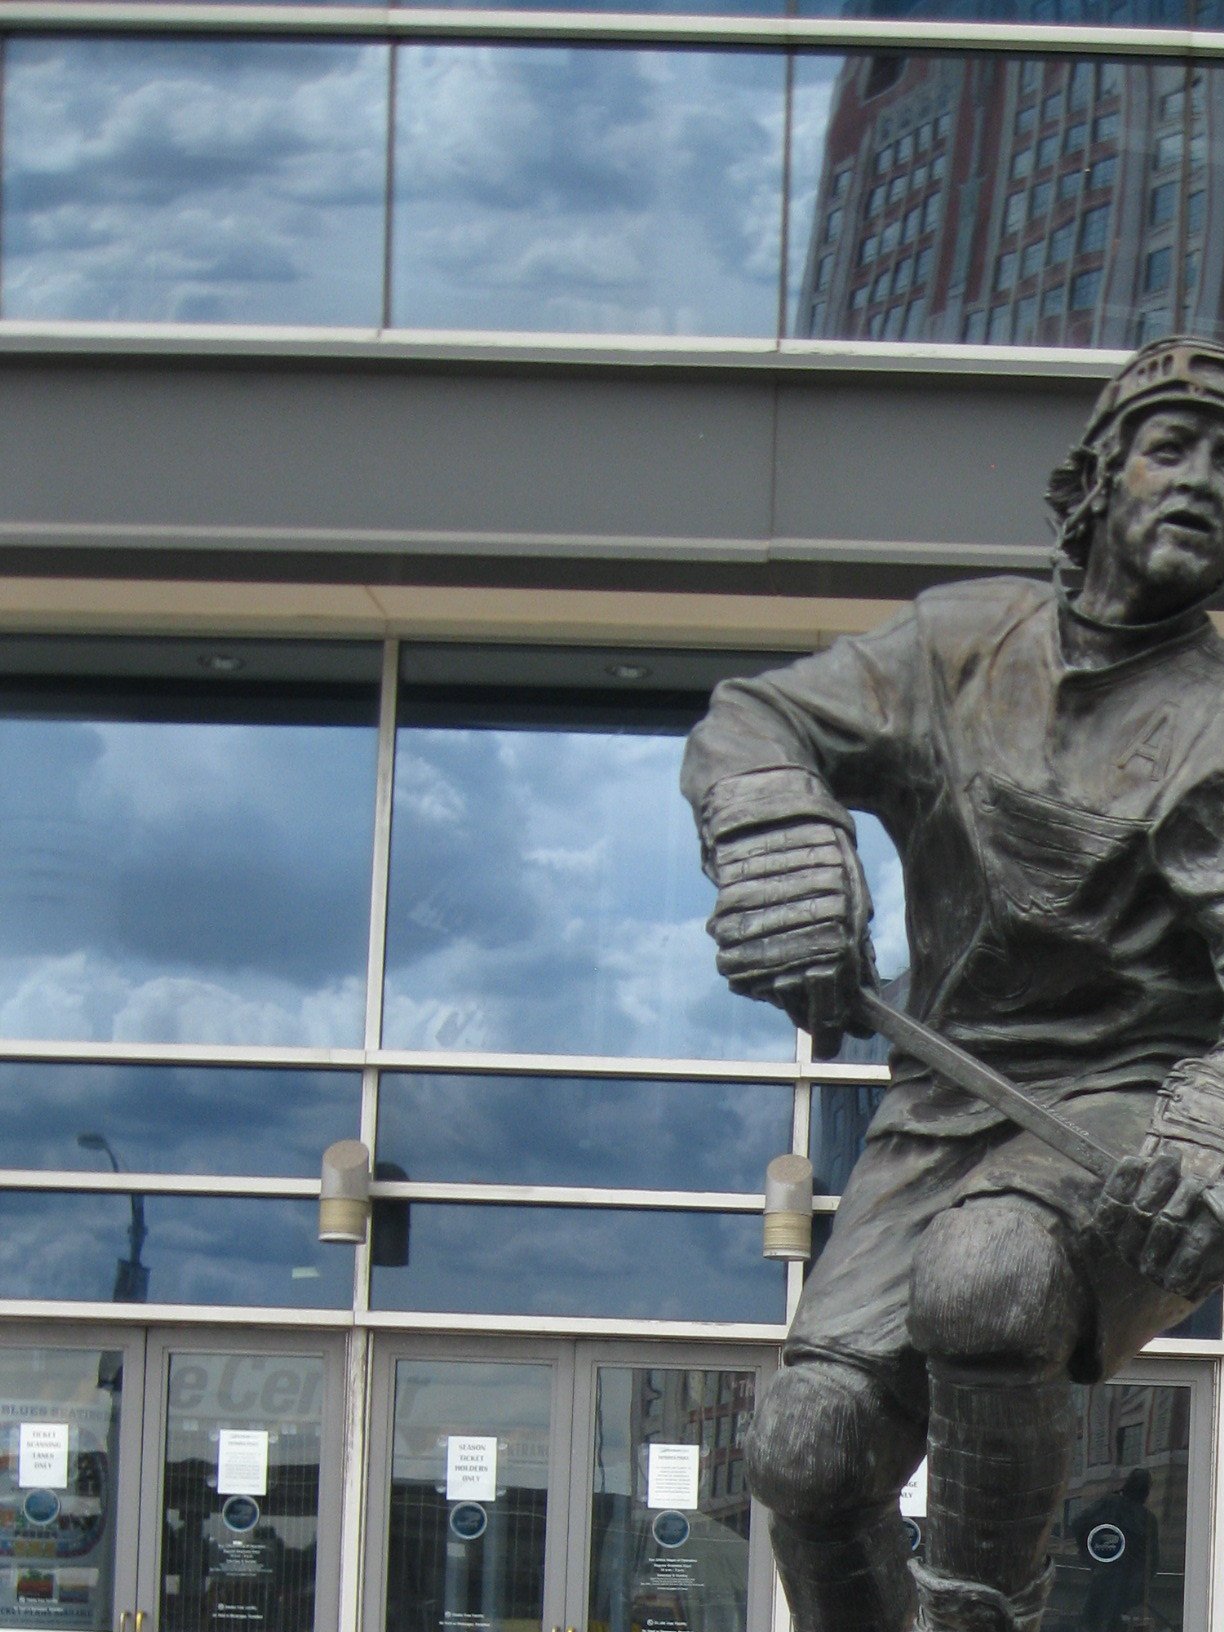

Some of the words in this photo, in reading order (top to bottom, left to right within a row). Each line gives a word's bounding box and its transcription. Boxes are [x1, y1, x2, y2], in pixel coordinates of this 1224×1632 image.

[1115, 699, 1180, 782] A
[458, 1443, 487, 1451] SEASON
[459, 1454, 484, 1462] TICKET
[454, 1464, 489, 1473] HOLDERS
[461, 1474, 481, 1483] ONLY
